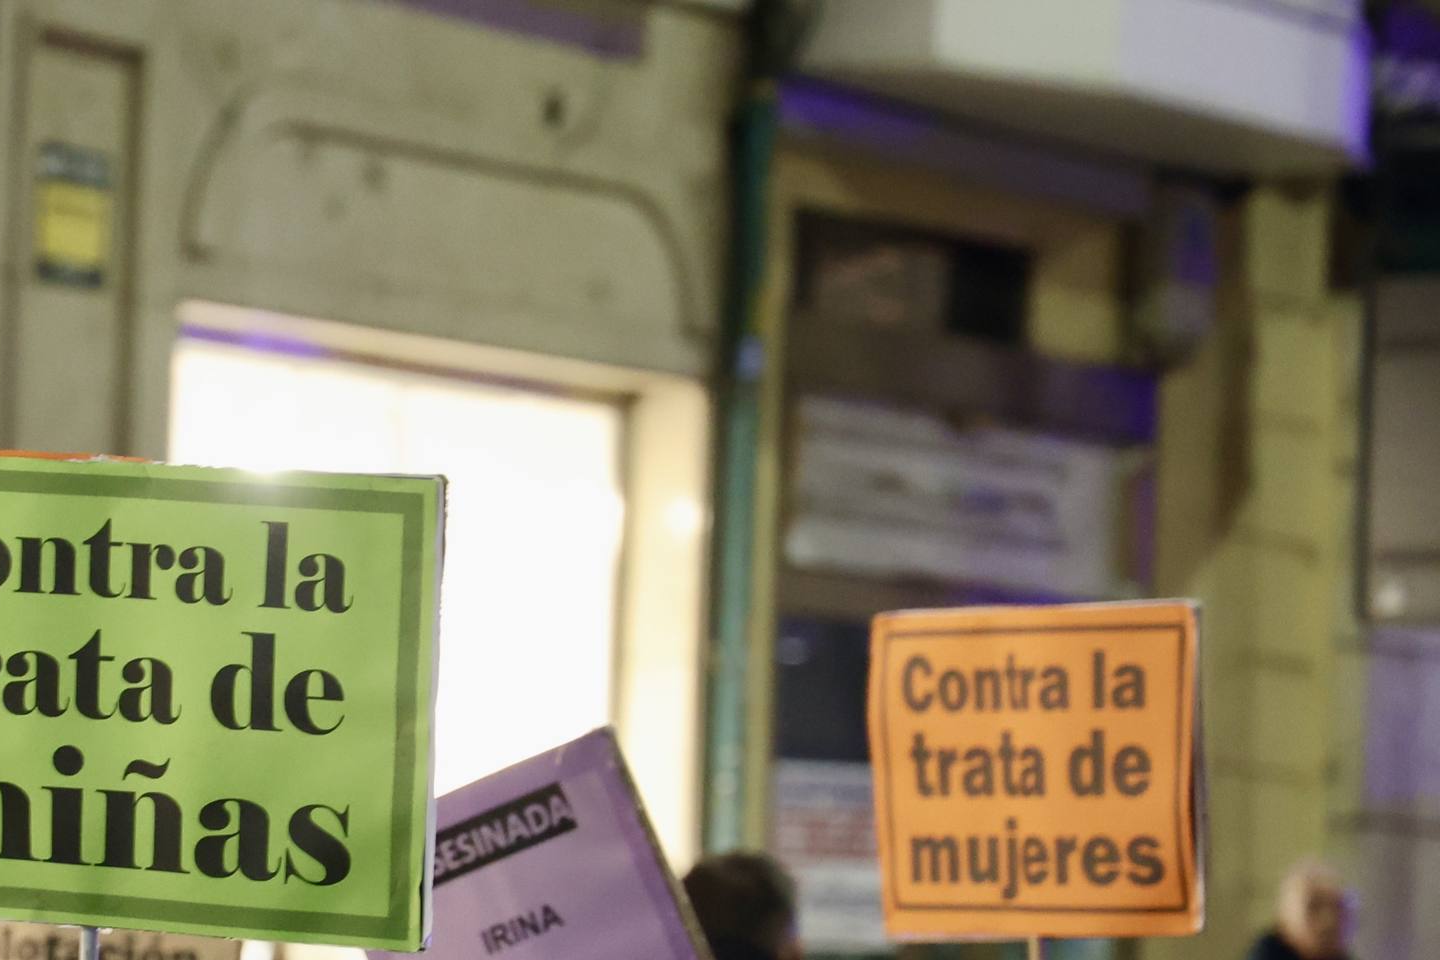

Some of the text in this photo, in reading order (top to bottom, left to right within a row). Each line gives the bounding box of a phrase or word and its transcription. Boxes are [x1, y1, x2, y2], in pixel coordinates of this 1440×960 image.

[258, 520, 353, 614] la
[210, 631, 346, 736] de
[901, 650, 1147, 713] Contra la
[910, 728, 1152, 798] trata de
[910, 817, 1167, 901] mujeres
[481, 904, 564, 954] IRINA
